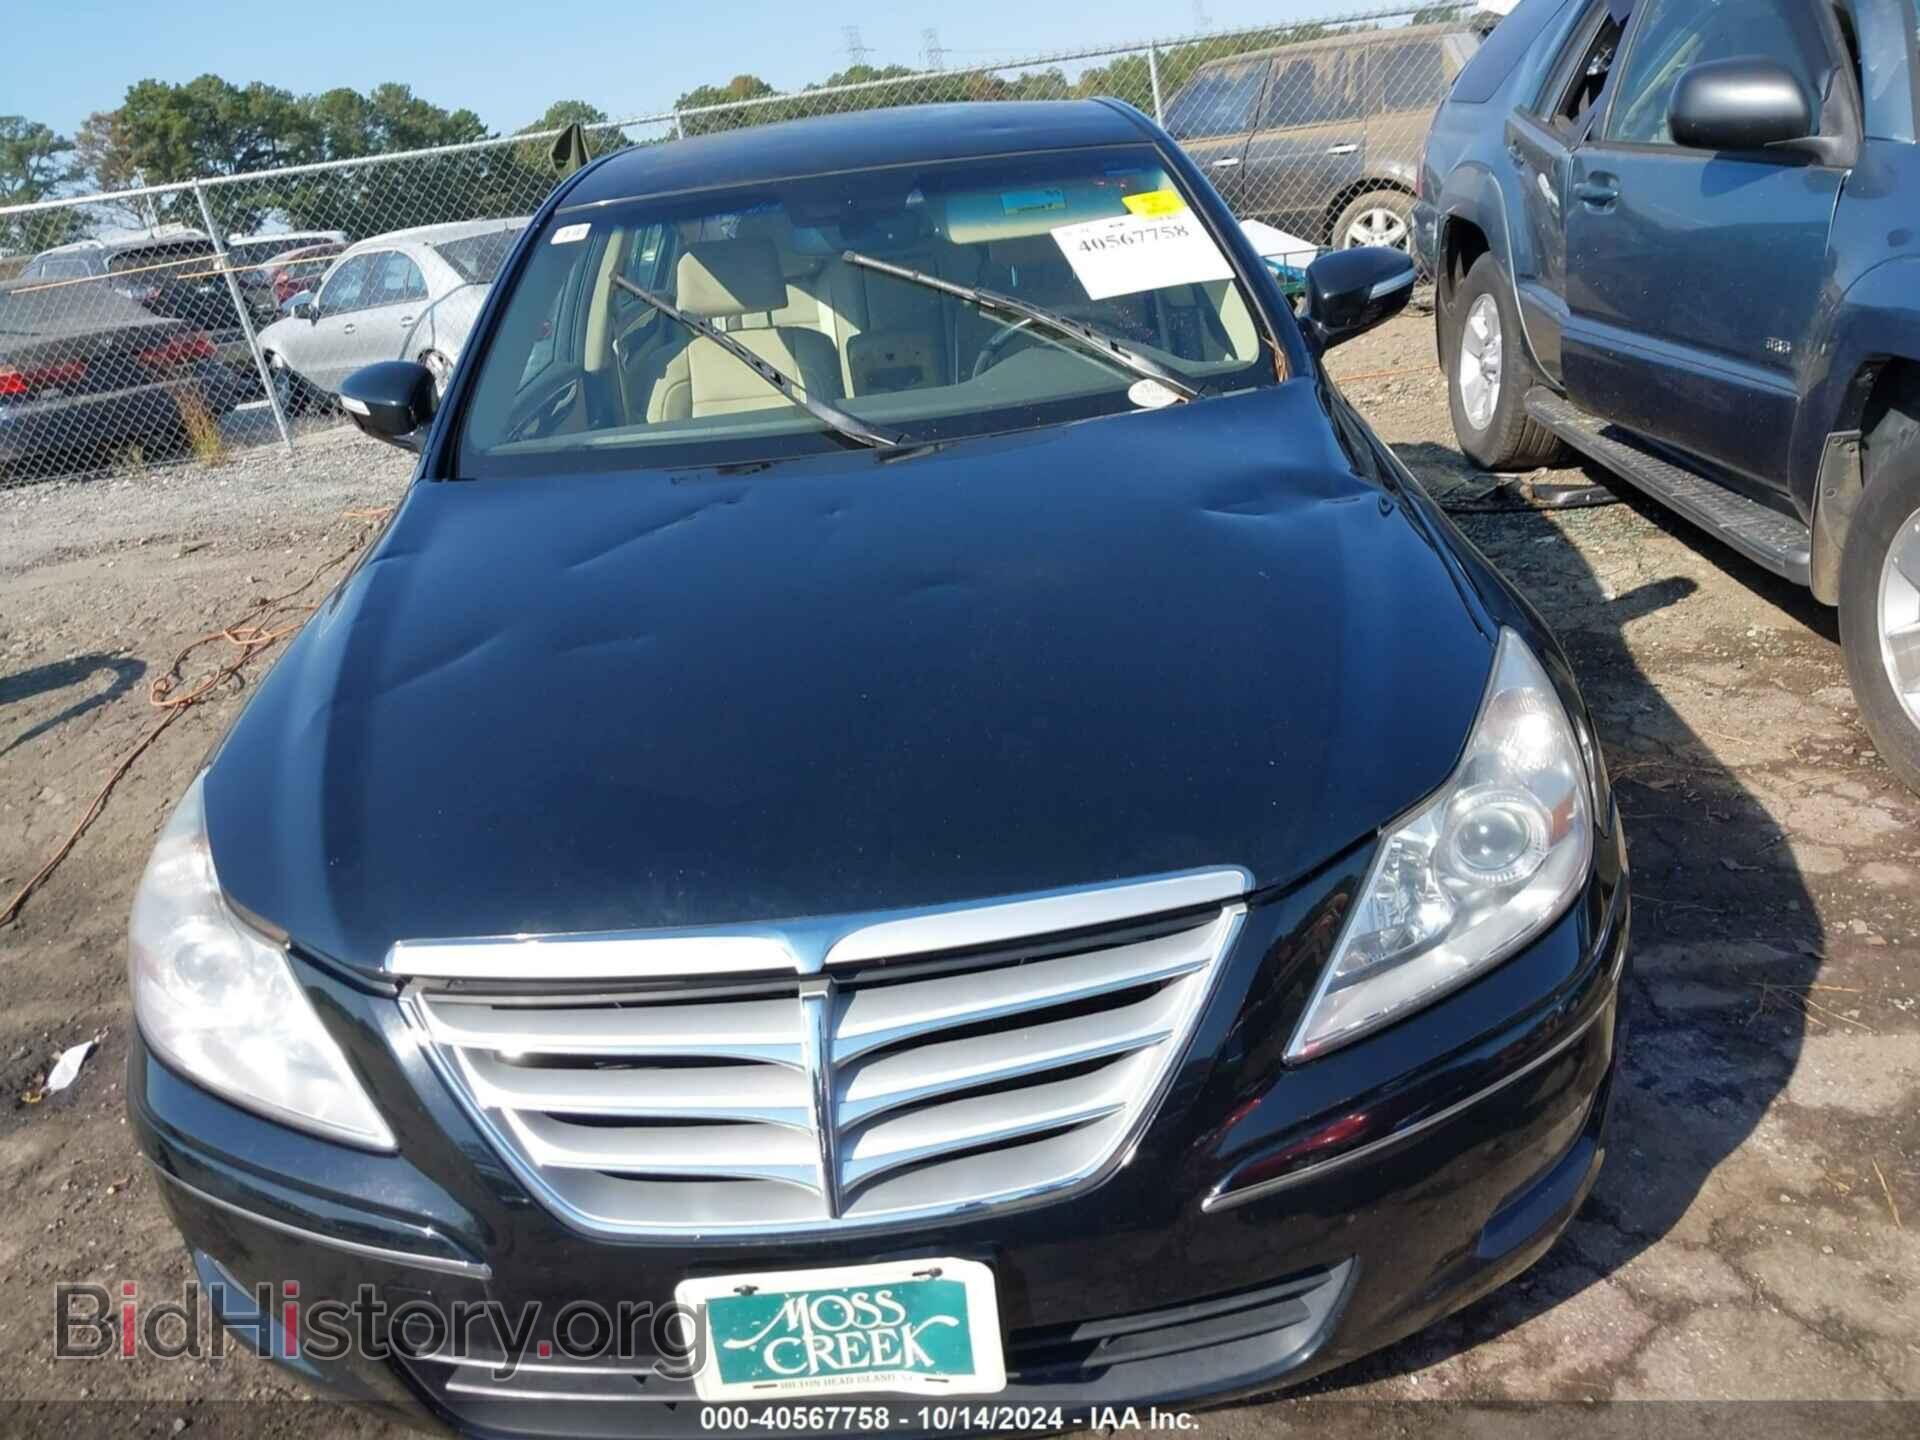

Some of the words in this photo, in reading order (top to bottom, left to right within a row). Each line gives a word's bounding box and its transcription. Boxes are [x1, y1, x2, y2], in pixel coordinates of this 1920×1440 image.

[1079, 224, 1190, 251] 40567758
[723, 1289, 906, 1348] MOSS
[763, 1315, 959, 1375] CREEK
